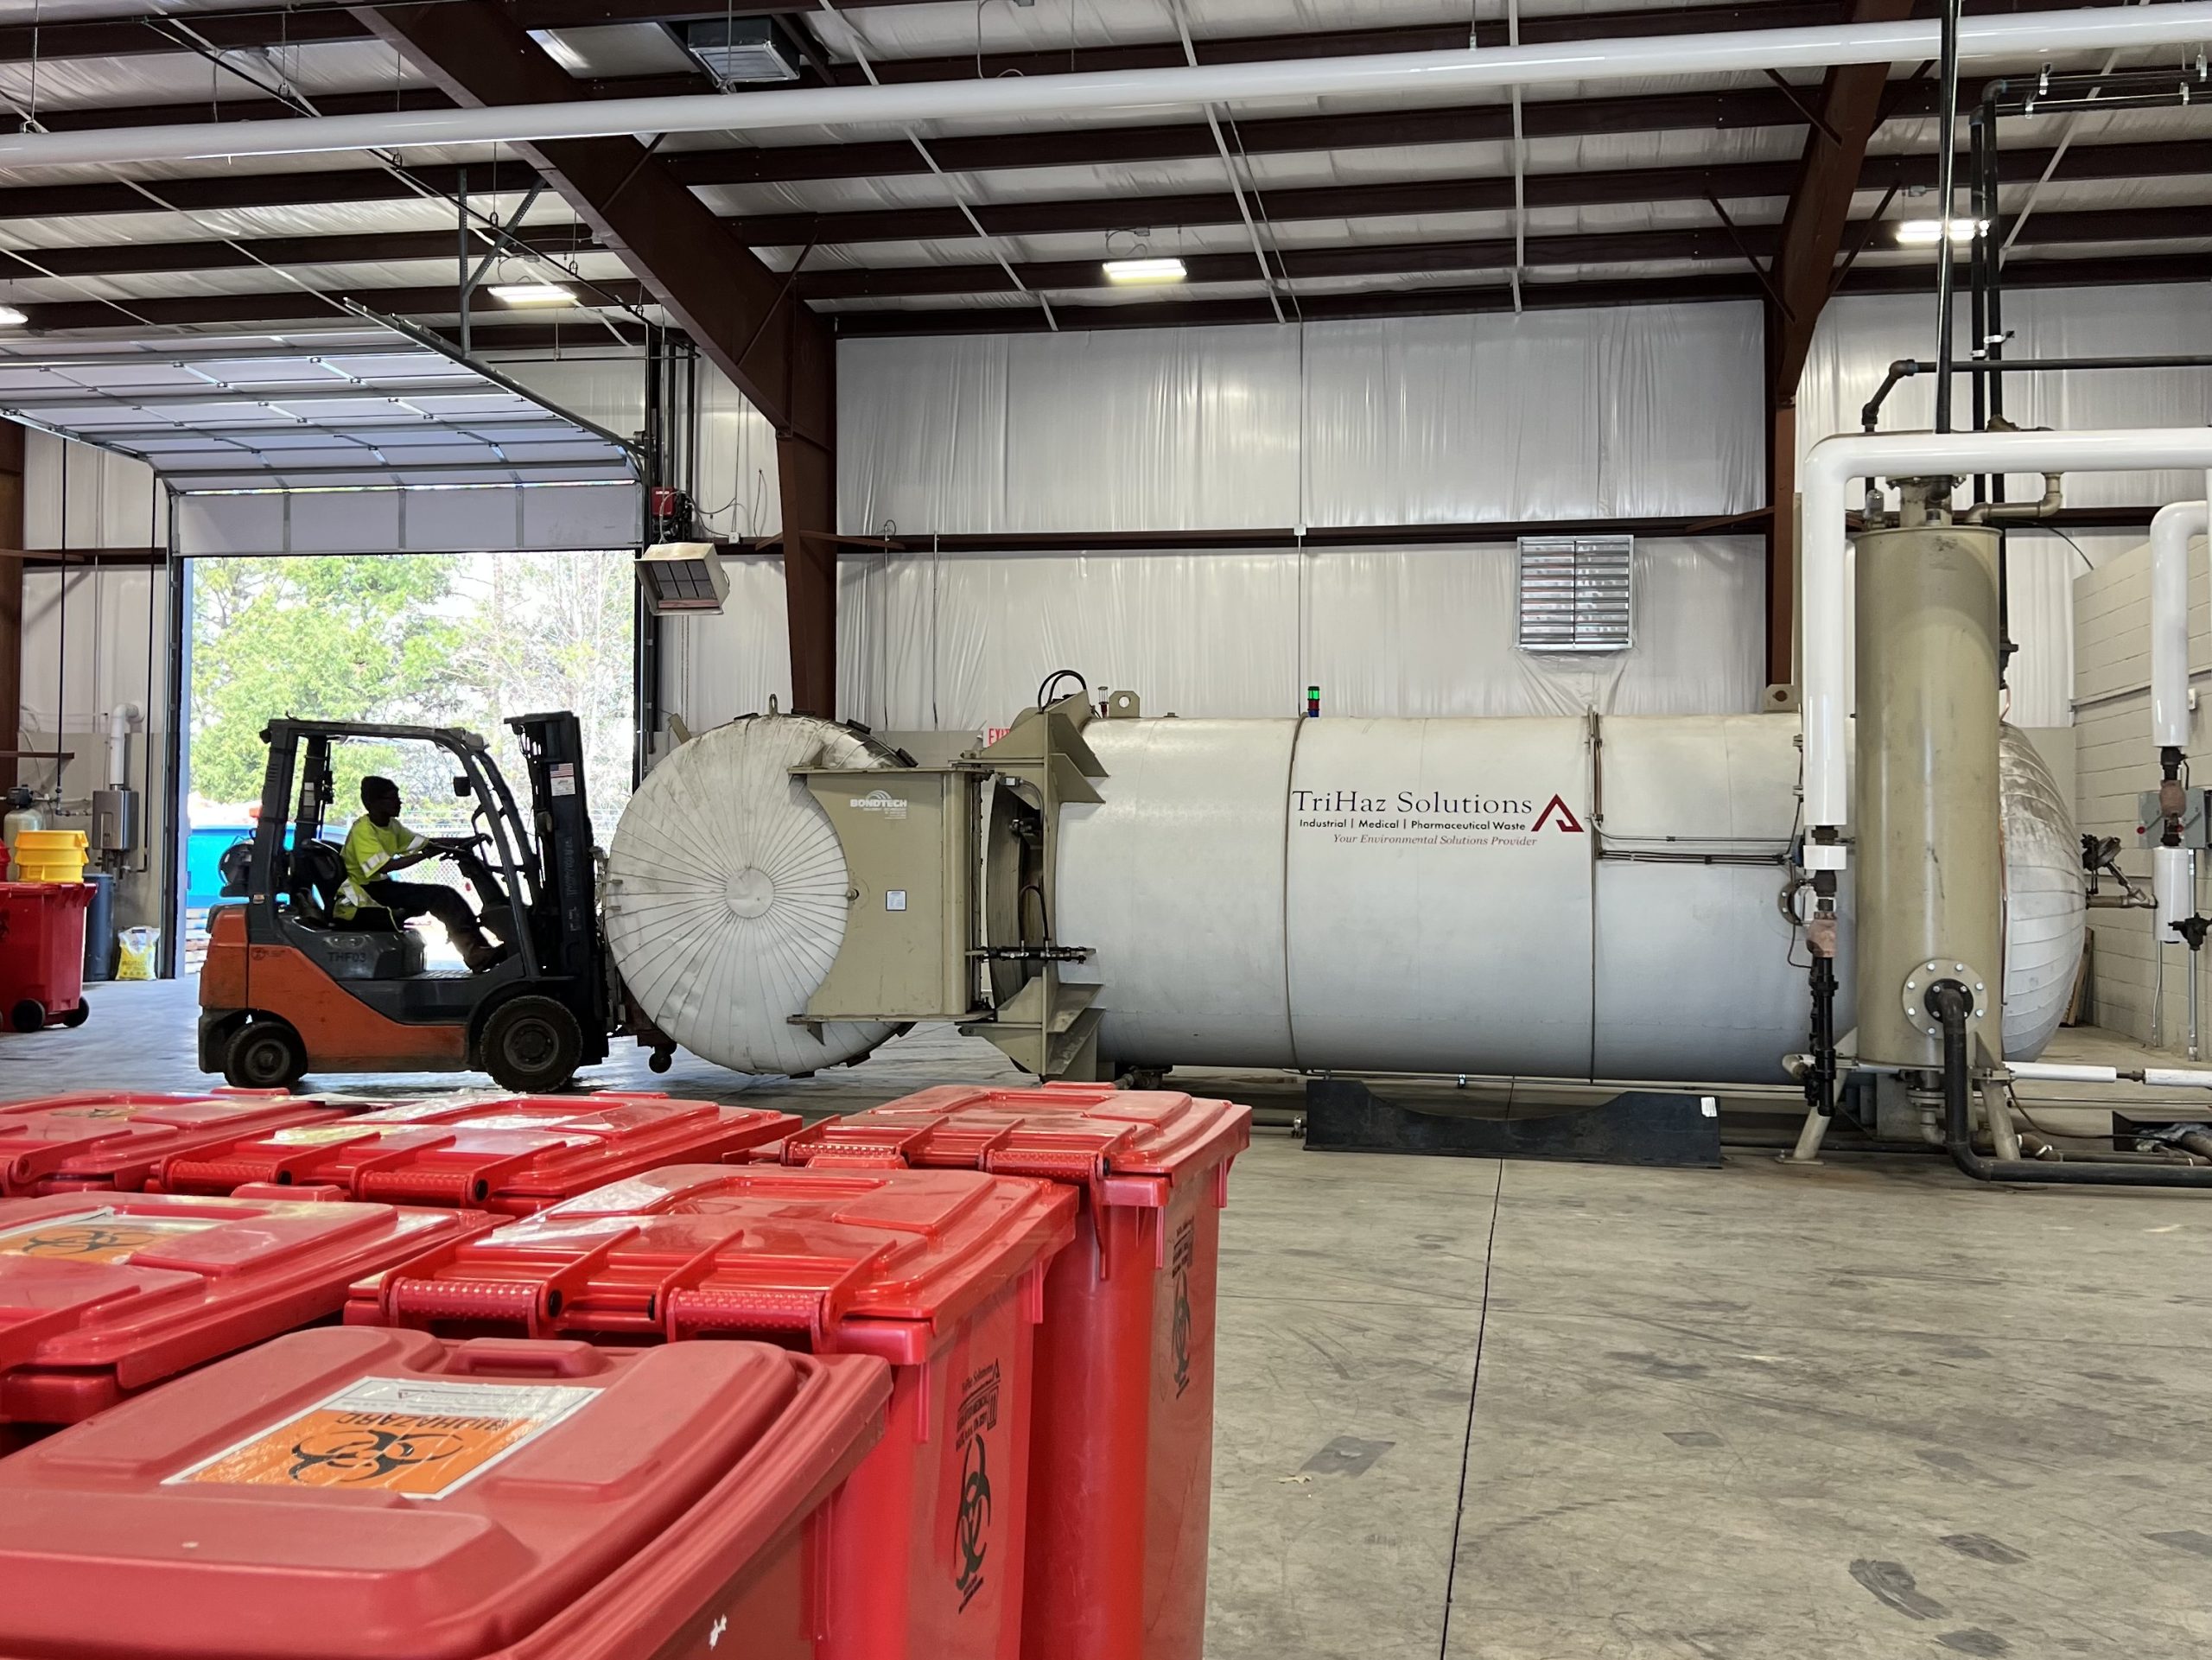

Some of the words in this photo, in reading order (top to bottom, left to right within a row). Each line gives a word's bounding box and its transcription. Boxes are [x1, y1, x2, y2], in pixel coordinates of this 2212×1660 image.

[988, 728, 1010, 746] EX
[850, 798, 907, 808] BONDTECH
[1292, 791, 1386, 812] TriHaz
[1397, 791, 1532, 814] Solutions
[1300, 818, 1346, 828] Industrial
[1358, 819, 1399, 829] Medical
[1411, 820, 1491, 830] Pharmaceutical
[1492, 821, 1526, 830] Waste
[1334, 834, 1358, 844] Your
[1360, 834, 1438, 845] Environmental
[1440, 835, 1488, 846] Solutions
[1491, 836, 1537, 847] Provider
